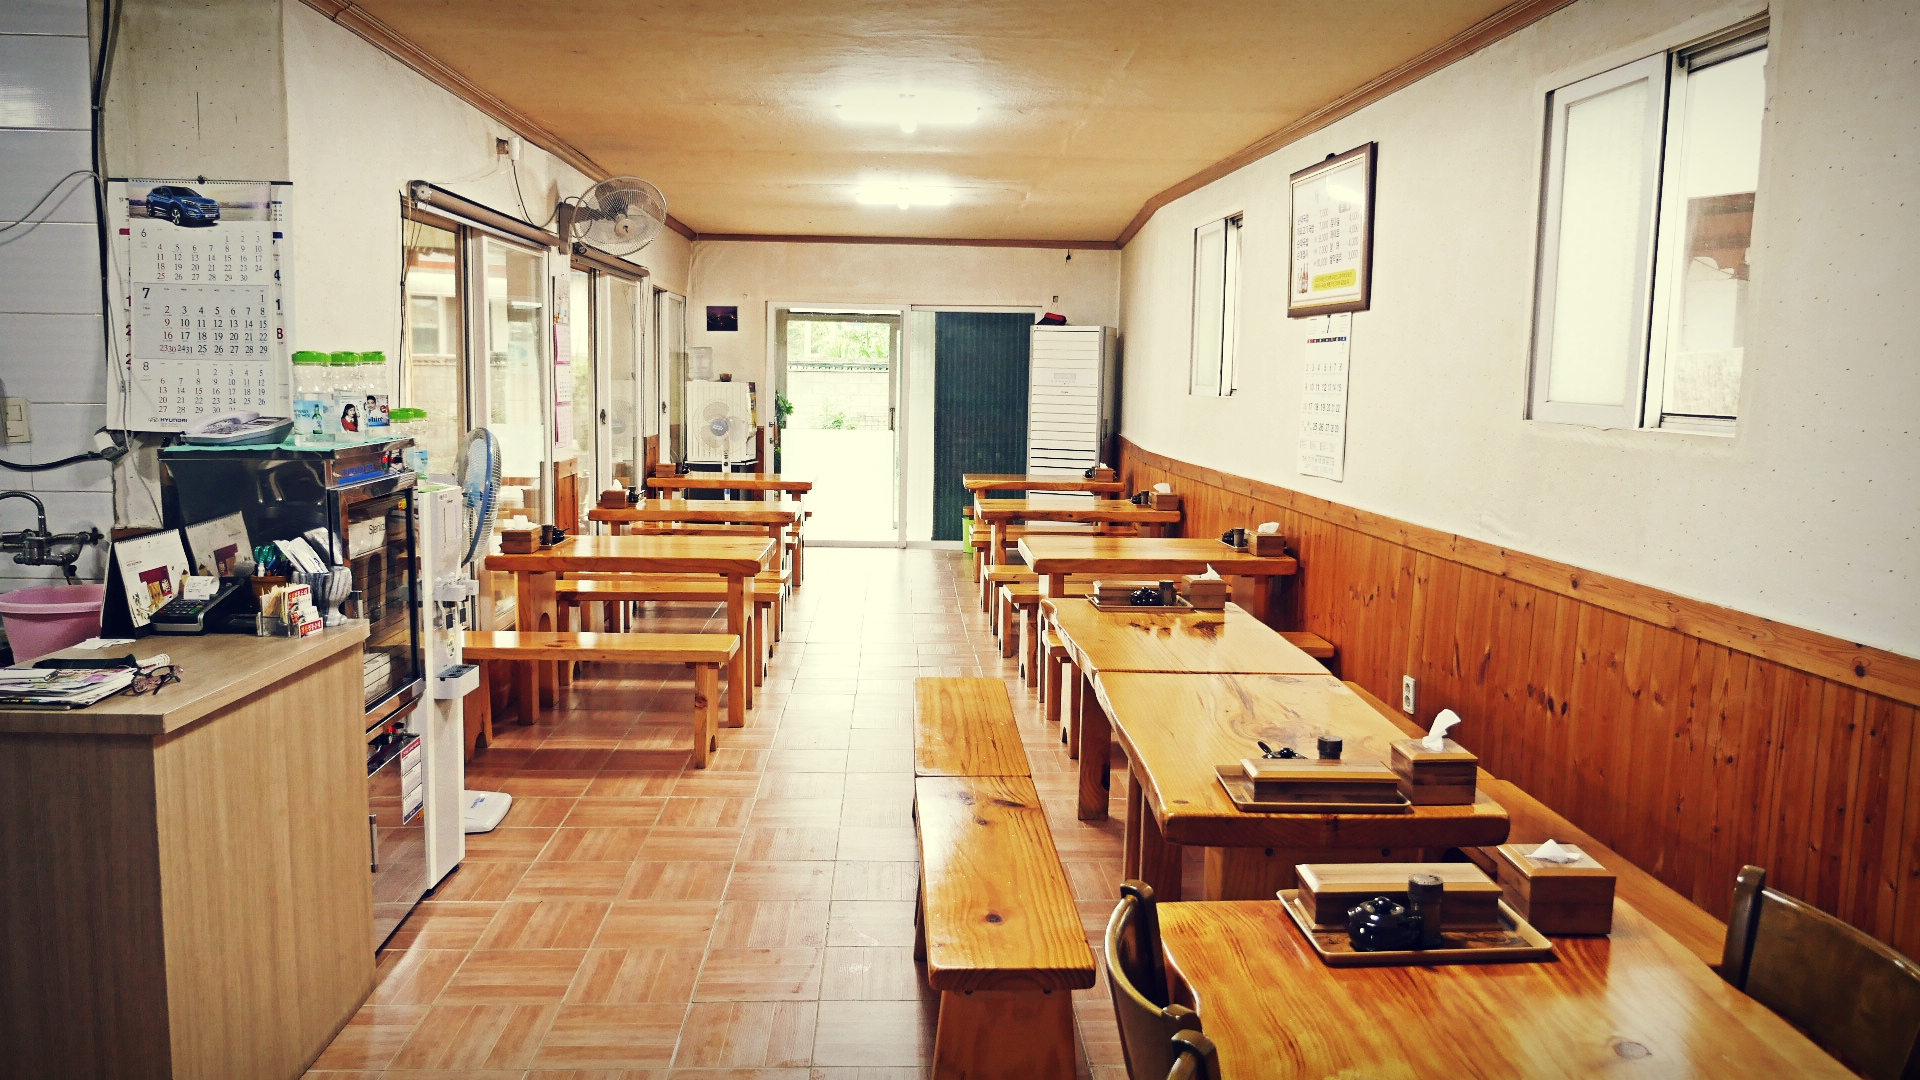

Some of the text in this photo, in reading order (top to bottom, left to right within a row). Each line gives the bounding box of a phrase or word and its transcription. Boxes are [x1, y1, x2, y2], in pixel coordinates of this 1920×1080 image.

[180, 318, 190, 327] 10
[197, 319, 206, 328] 11
[214, 319, 223, 328] 12
[229, 319, 239, 328] 13
[245, 320, 254, 329] 14
[259, 320, 268, 329] 15
[163, 331, 268, 341] 16 17 18 19 20 21 22
[159, 344, 169, 353] 23
[177, 344, 186, 352] 24
[185, 346, 193, 354] 31
[197, 344, 208, 353] 25
[214, 344, 224, 354] 26
[229, 345, 239, 354] 27
[245, 345, 254, 354] 28
[259, 345, 268, 354] 29
